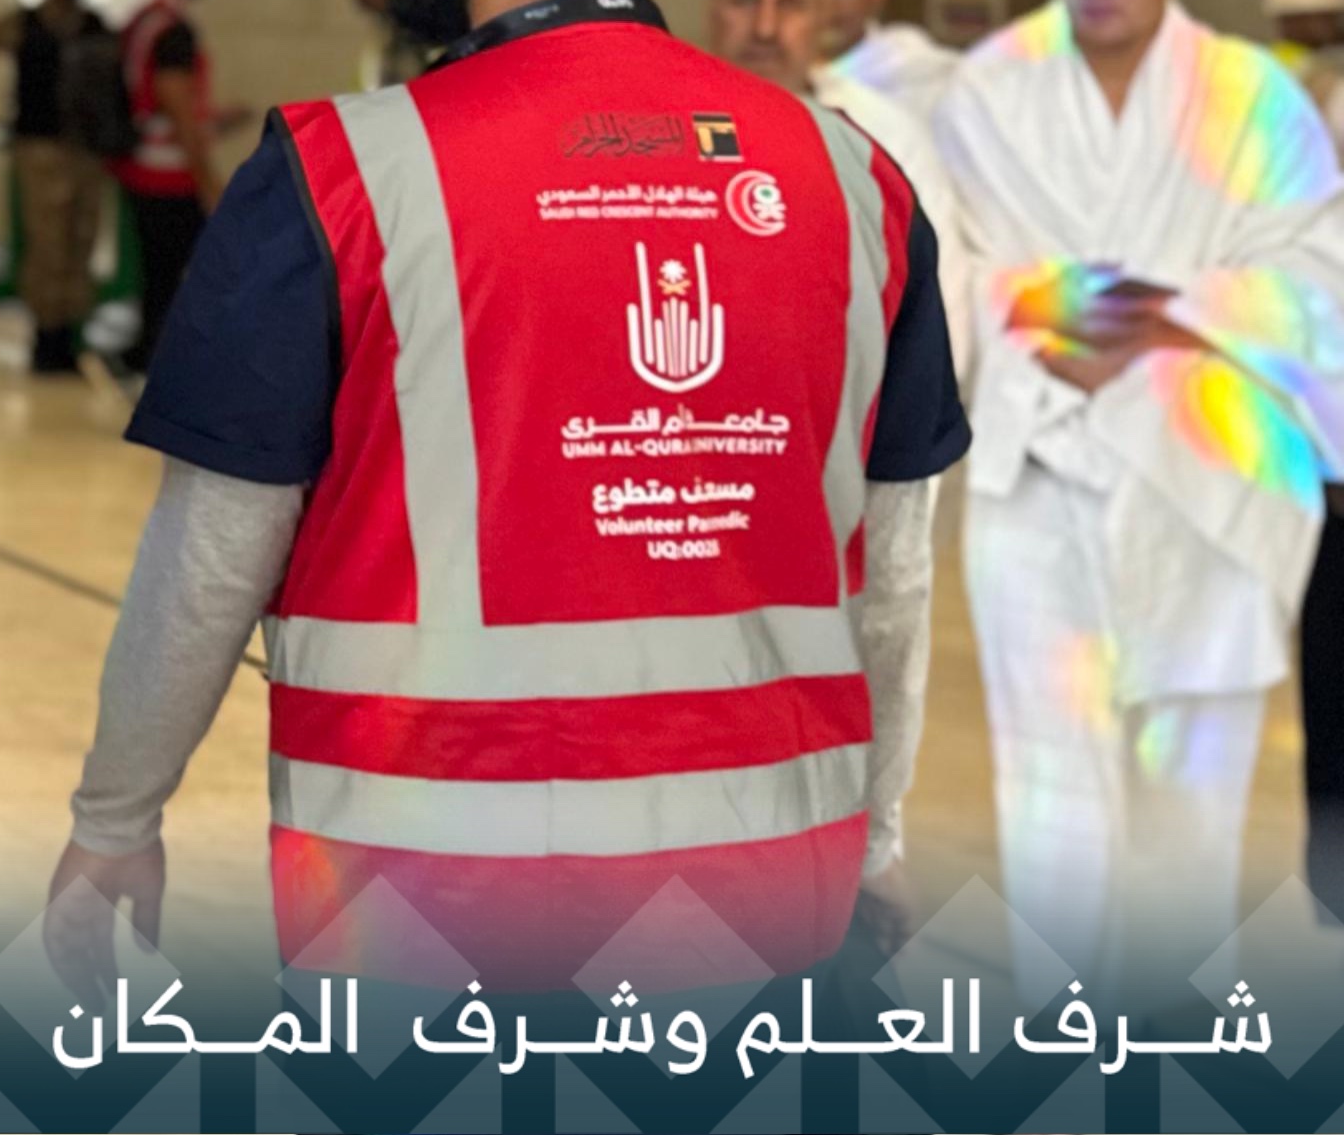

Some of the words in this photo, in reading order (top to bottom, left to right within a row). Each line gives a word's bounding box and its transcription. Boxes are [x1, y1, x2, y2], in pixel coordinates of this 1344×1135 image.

[561, 407, 661, 440] القرى
[562, 441, 606, 459] UMM
[690, 437, 787, 455] NIVERSITY
[592, 477, 676, 514] متطوع
[595, 516, 684, 536] Volunteer
